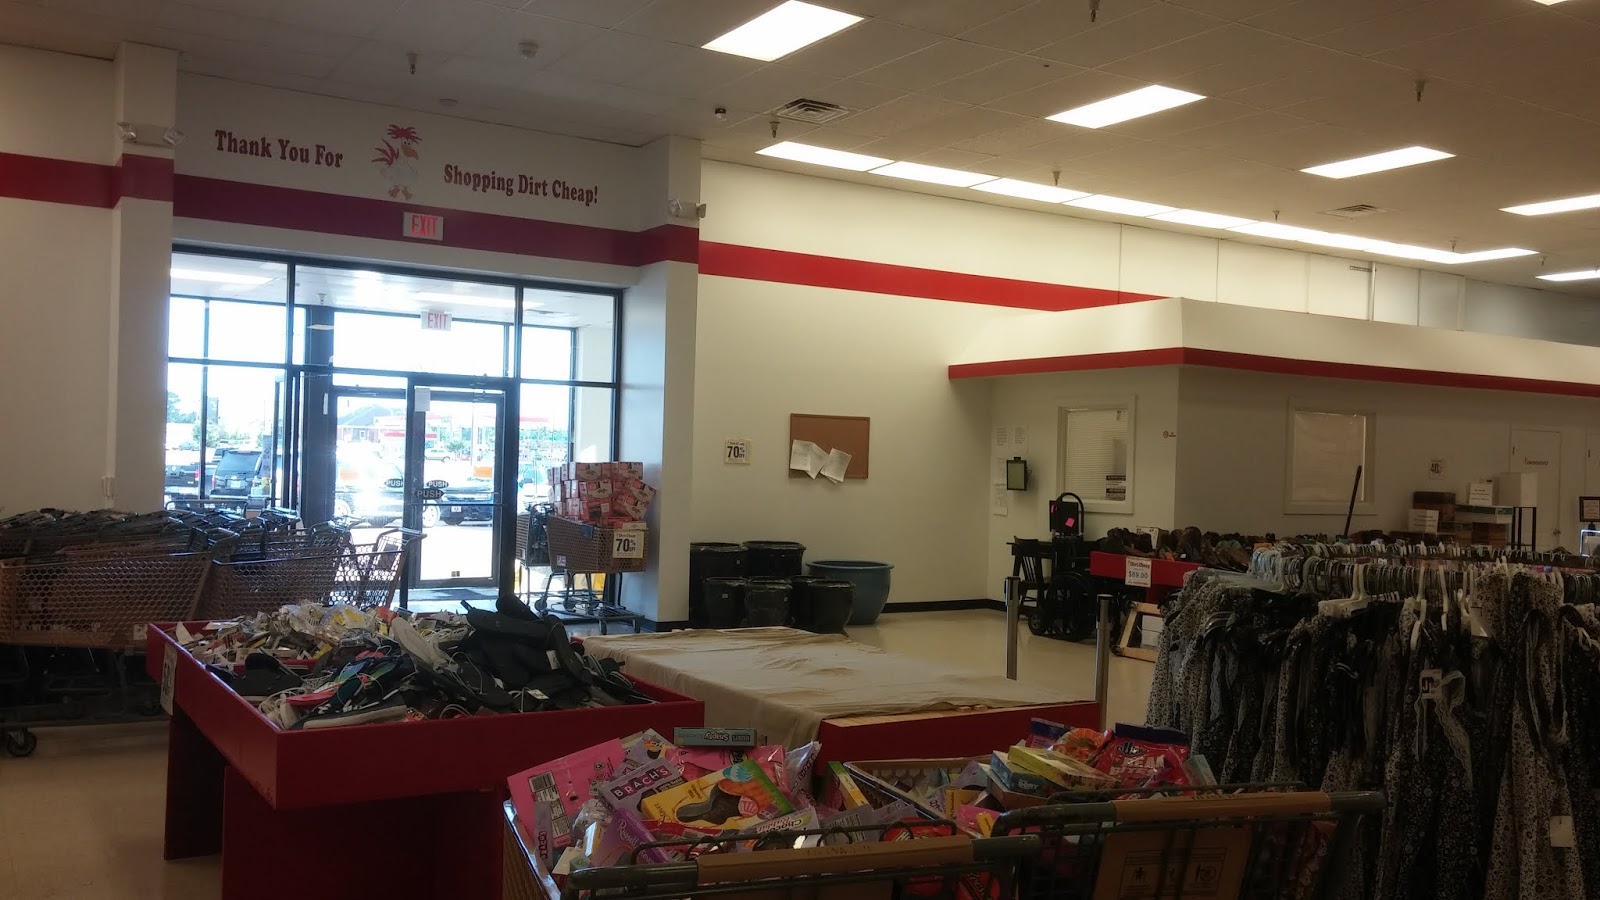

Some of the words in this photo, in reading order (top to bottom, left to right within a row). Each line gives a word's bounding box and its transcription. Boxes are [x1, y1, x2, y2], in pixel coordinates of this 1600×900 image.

[214, 129, 272, 158] Thank
[277, 138, 310, 163] You
[314, 144, 343, 168] For
[443, 164, 514, 197] Shopping
[518, 174, 548, 197] Dirt
[551, 179, 598, 207] Cheap!
[411, 214, 438, 238] EXIT
[427, 312, 448, 330] EXIT
[417, 490, 442, 498] PUSH
